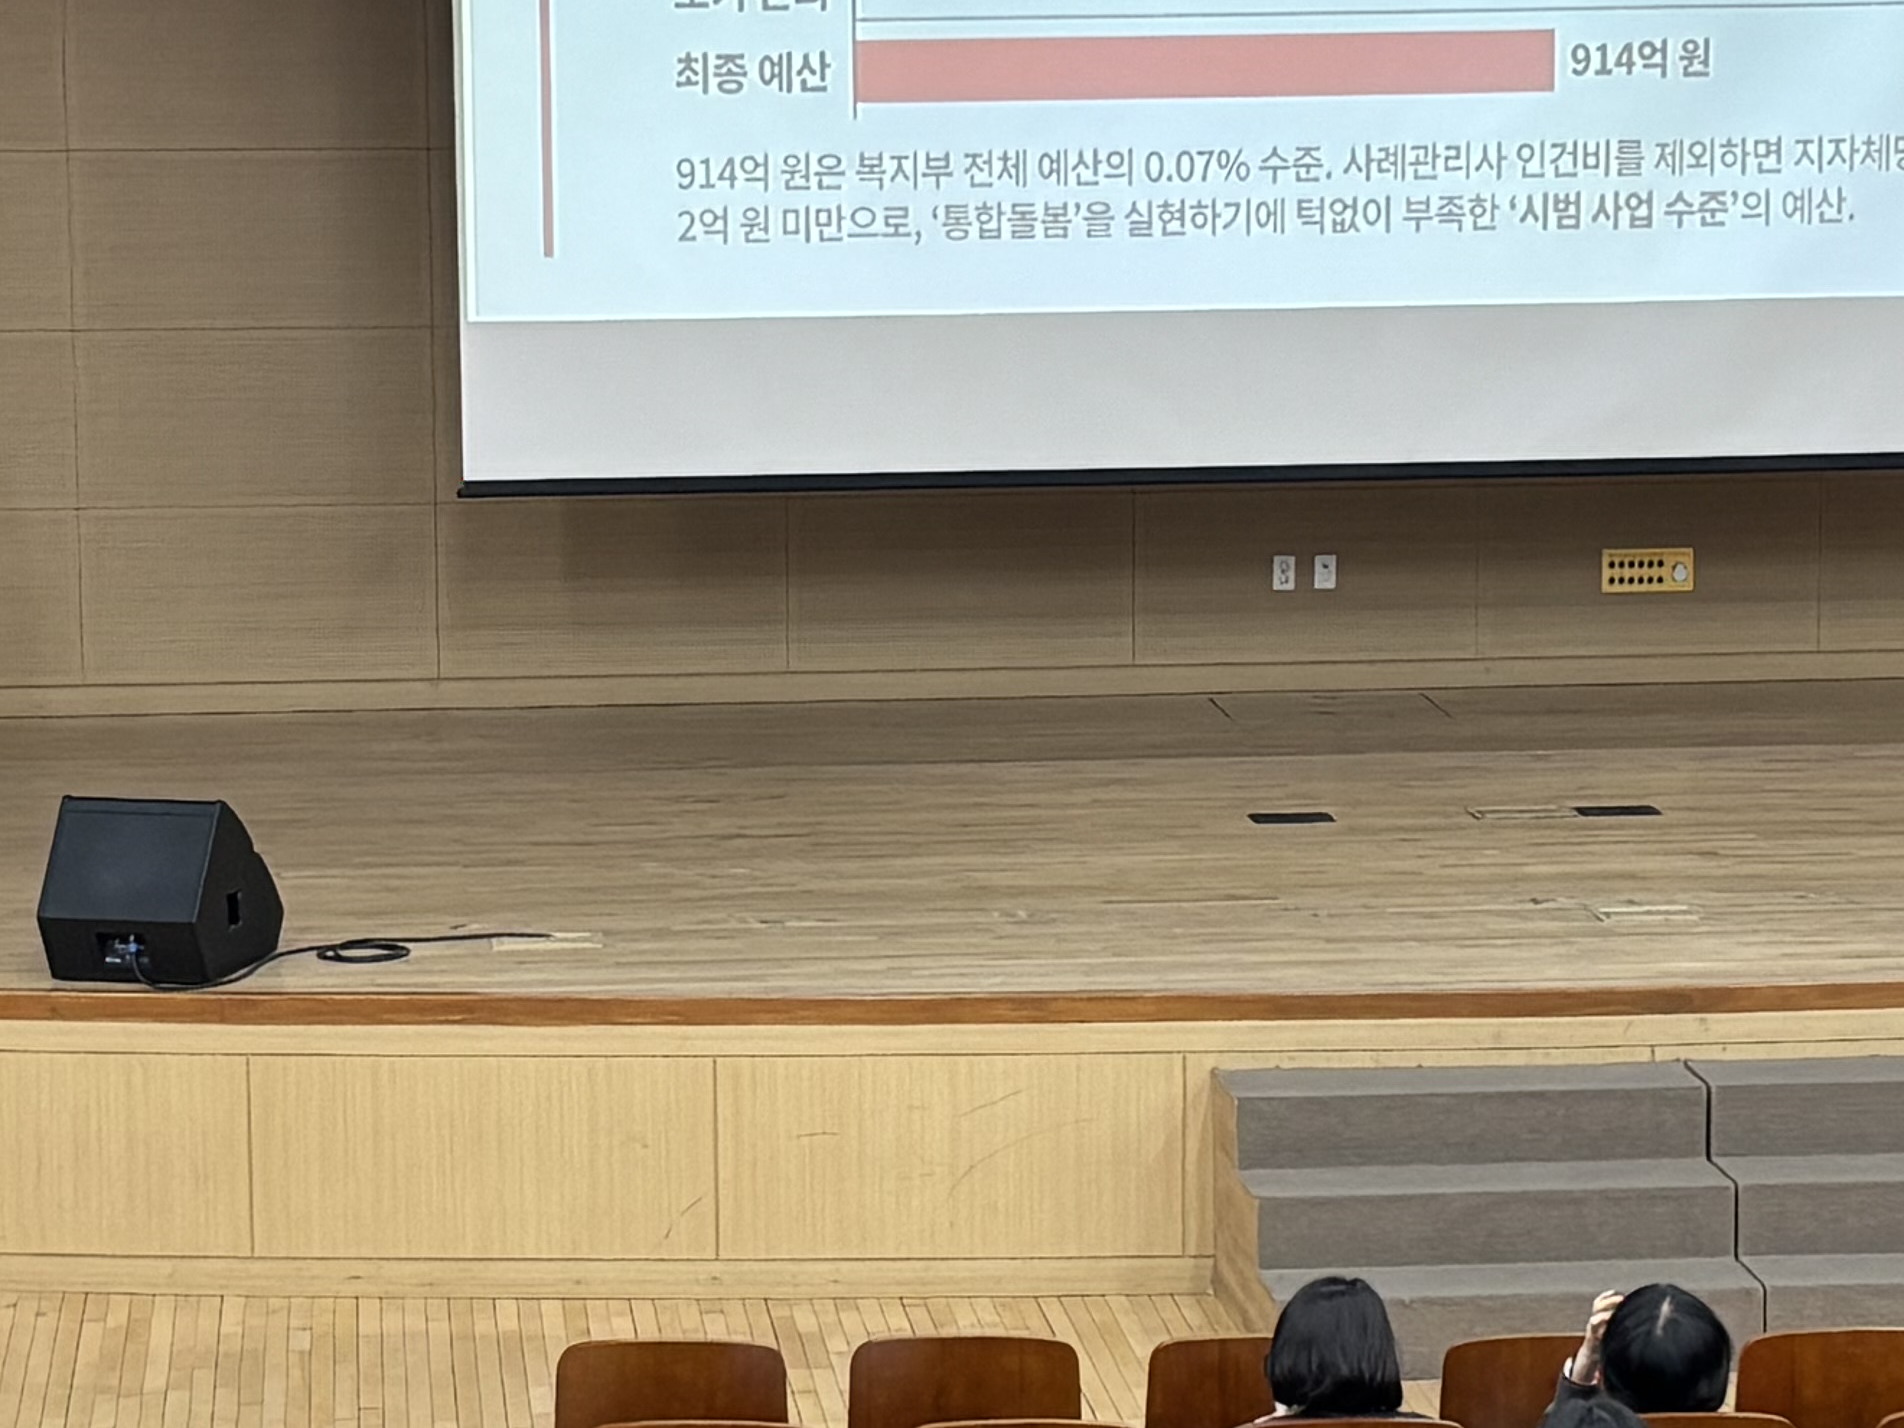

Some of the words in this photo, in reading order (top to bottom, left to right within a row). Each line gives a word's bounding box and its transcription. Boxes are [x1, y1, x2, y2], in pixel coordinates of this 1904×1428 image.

[675, 51, 749, 96] 최종
[758, 49, 832, 95] 예산
[1570, 36, 1668, 80] 914억
[1678, 36, 1711, 78] 원
[676, 151, 769, 193] 914억
[780, 150, 846, 192] 원은
[855, 149, 954, 192] 복지부
[963, 148, 1028, 189] 전체
[1037, 146, 1134, 188] 예산의
[1144, 147, 1251, 184] 0.07%
[1258, 145, 1333, 185] 수준.
[1342, 139, 1509, 183] 사례관리사
[1516, 138, 1646, 179] 인건비를
[1653, 134, 1783, 178] 제외하면
[677, 204, 729, 246] 2억
[739, 204, 771, 244] 원
[782, 203, 922, 247] 미만으로,
[1123, 197, 1286, 238] 실현하기에
[1296, 194, 1392, 236] 턱없이
[1402, 192, 1501, 234] 부족한
[1591, 188, 1654, 231] 사업
[1782, 185, 1855, 226] 예산.
